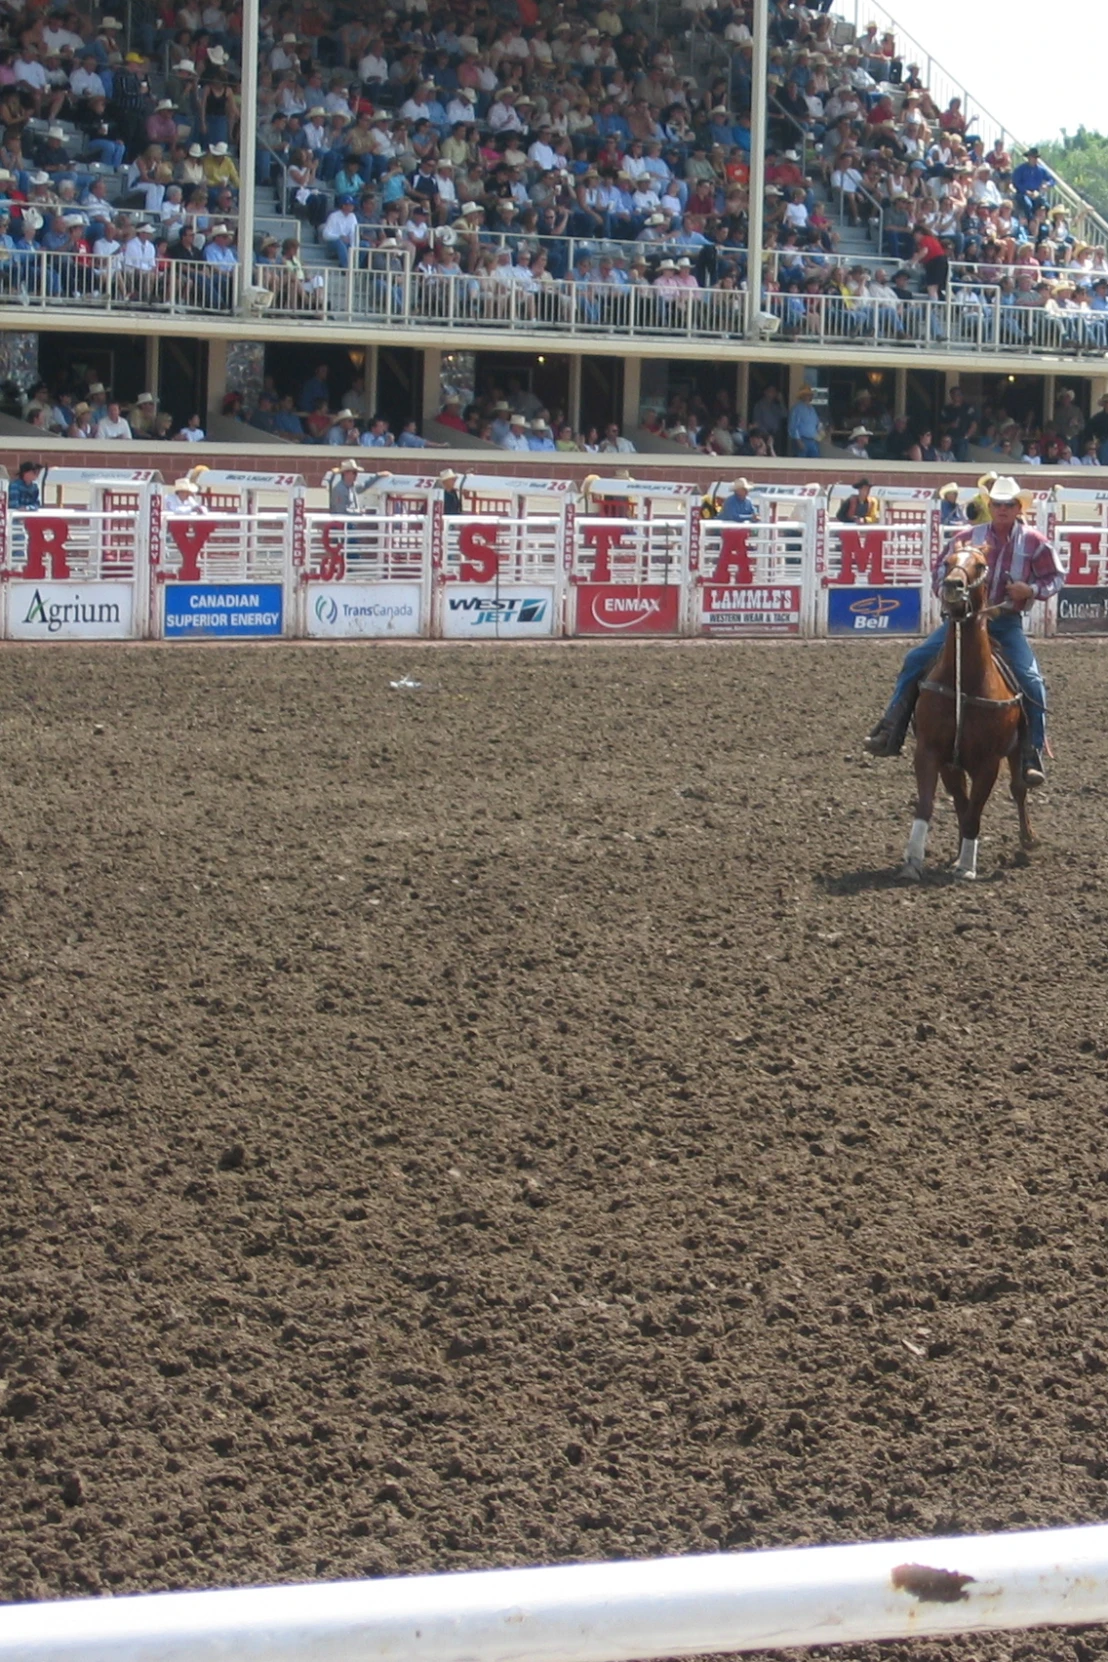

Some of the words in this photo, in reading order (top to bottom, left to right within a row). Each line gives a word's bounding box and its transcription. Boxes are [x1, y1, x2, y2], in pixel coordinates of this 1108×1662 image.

[131, 471, 152, 480] 23
[274, 475, 294, 485] 24
[415, 478, 434, 488] 25
[547, 481, 567, 491] 26
[673, 485, 694, 494] 27
[797, 487, 817, 497] 28
[911, 489, 932, 499] 29
[150, 496, 161, 561] CALGARY
[189, 594, 260, 608] CANADIAN
[449, 597, 522, 610] WEST
[604, 598, 660, 612] ENMAX
[711, 589, 792, 609] LAMMLE'S
[22, 588, 120, 632] Agrium
[343, 604, 413, 616] TransCanada
[166, 613, 228, 627] SUPERIOR
[230, 612, 279, 626] ENERGY
[470, 611, 518, 625] JET
[709, 613, 741, 622] WESTERN
[743, 613, 764, 622] WEAR
[773, 613, 790, 622] TACK
[854, 616, 889, 629] Bell
